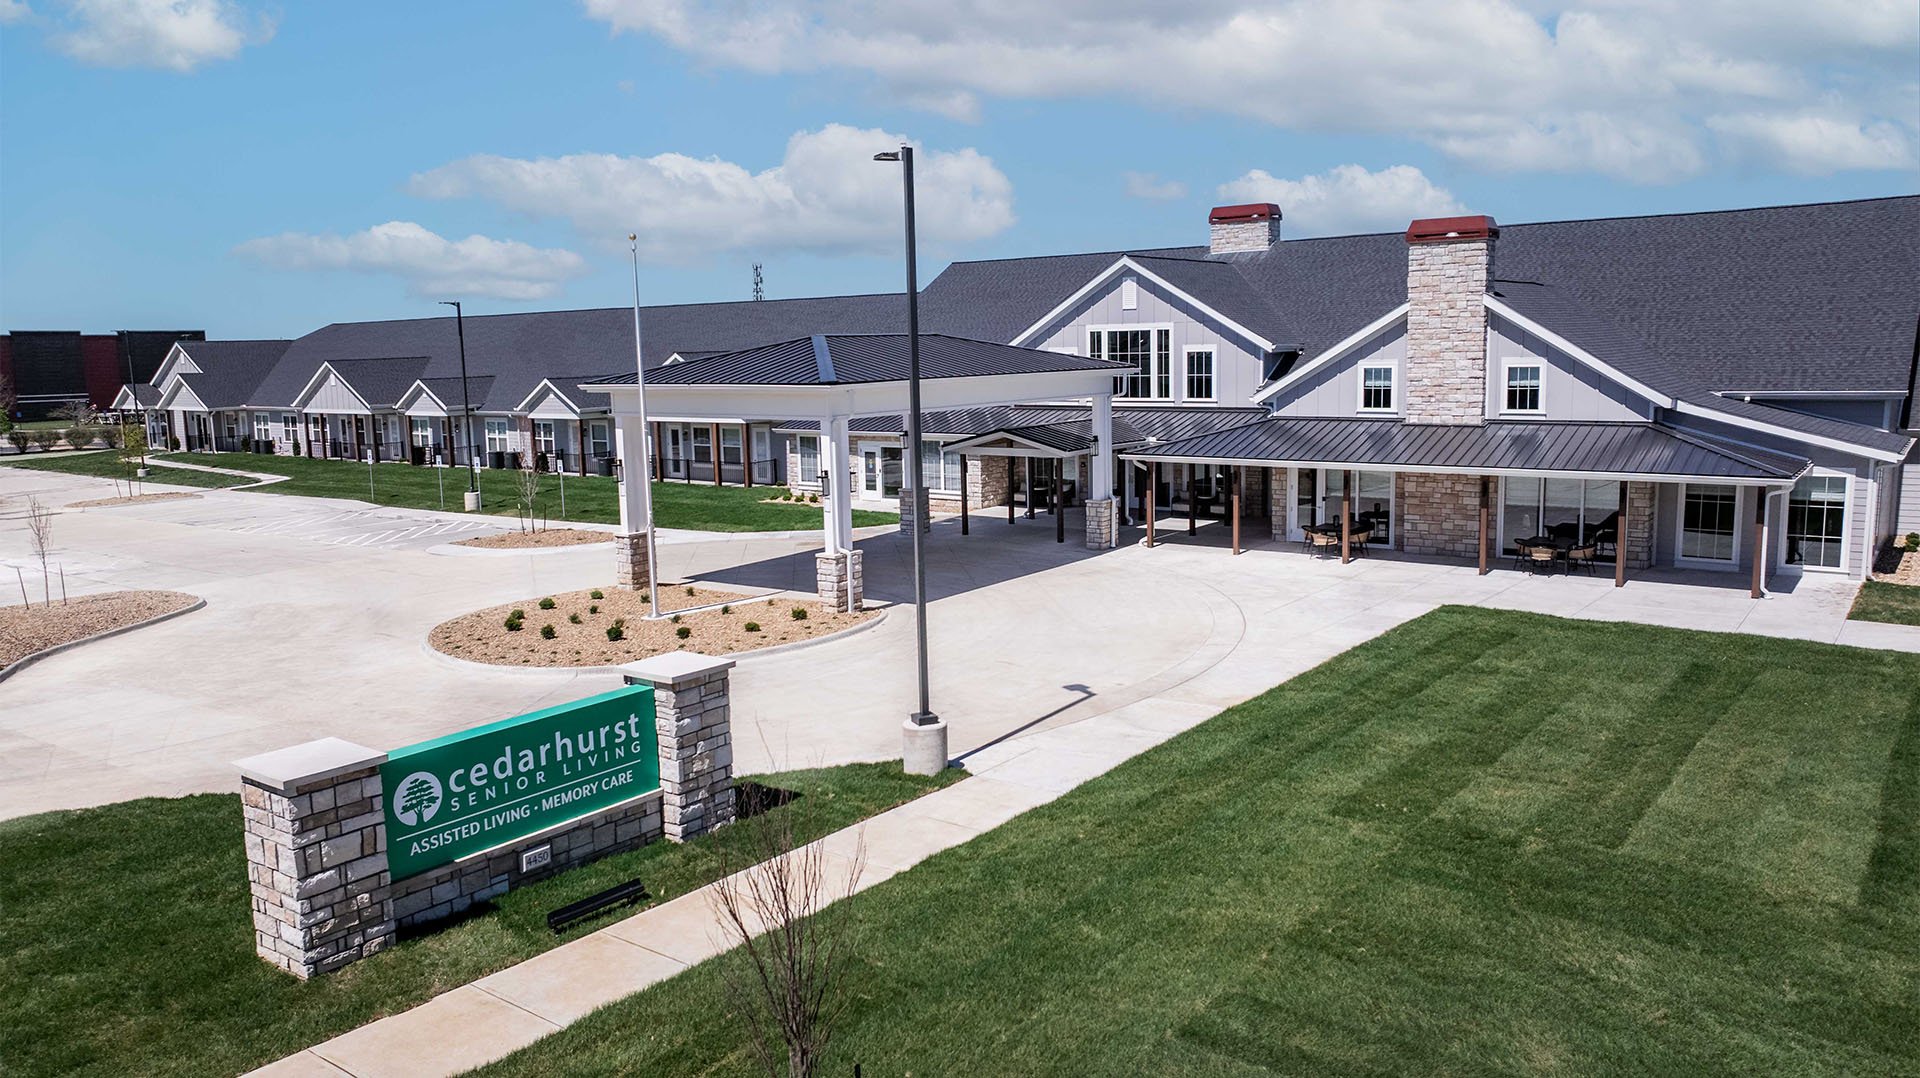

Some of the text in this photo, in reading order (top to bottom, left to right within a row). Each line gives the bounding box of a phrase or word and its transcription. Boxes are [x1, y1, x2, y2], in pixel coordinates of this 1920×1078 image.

[449, 713, 640, 793] cedarhurst
[450, 741, 641, 812] SENIOR LIVING
[410, 770, 633, 856] ASSISTED LIVING MEMORY CARE
[526, 851, 549, 867] 4450
